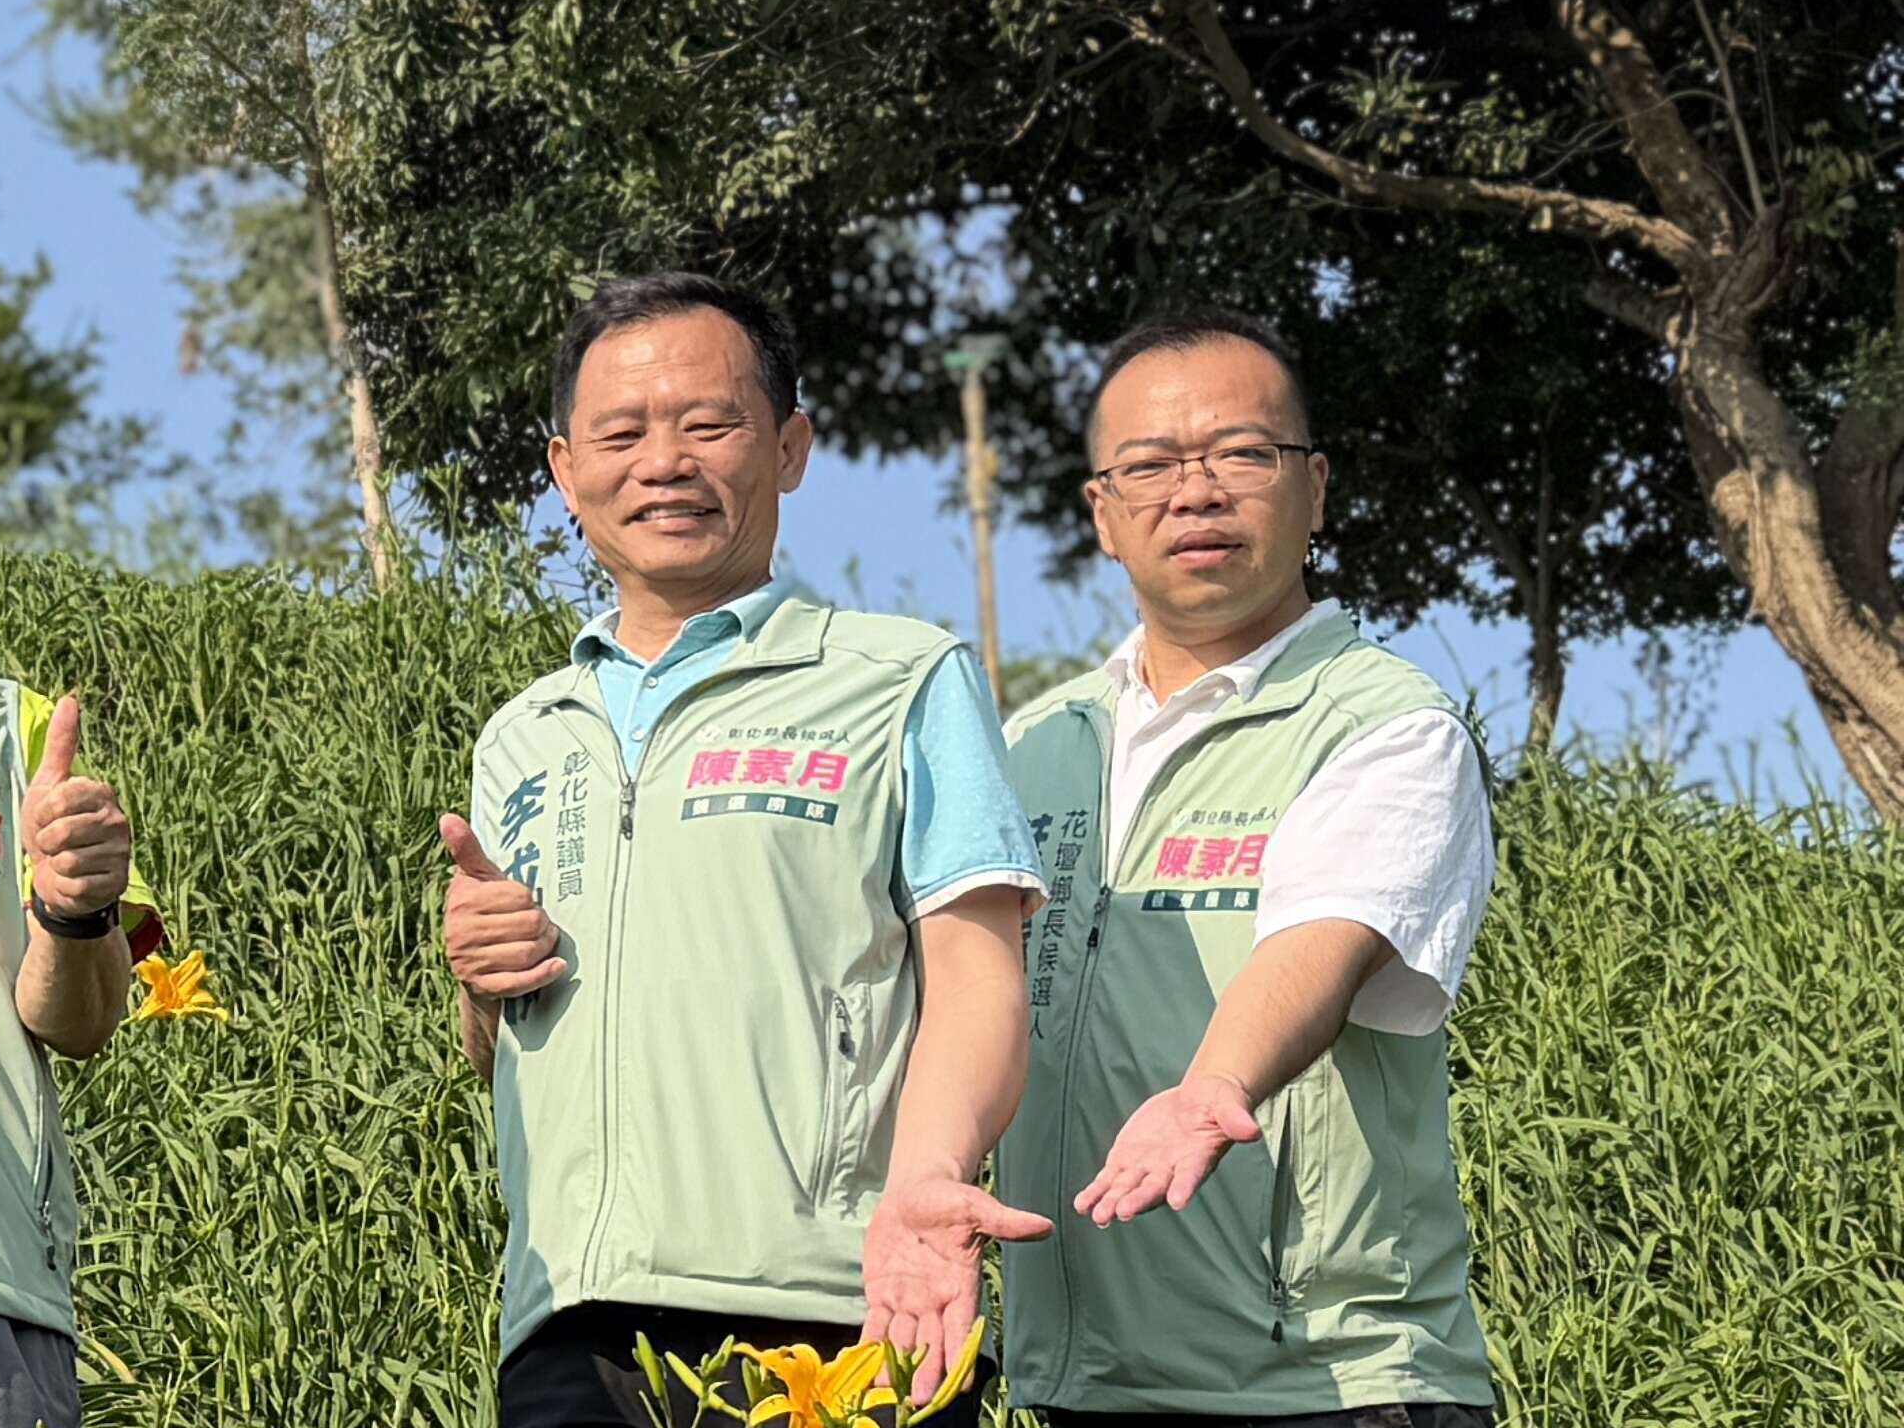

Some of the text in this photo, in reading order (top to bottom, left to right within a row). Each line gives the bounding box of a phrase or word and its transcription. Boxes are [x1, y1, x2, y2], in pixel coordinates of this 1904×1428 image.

[687, 748, 850, 791] 陳素月
[555, 750, 591, 902] 彰化縣議員
[1154, 834, 1270, 880] 陳素月
[1029, 809, 1089, 1040] 花壇鄉長候選人
